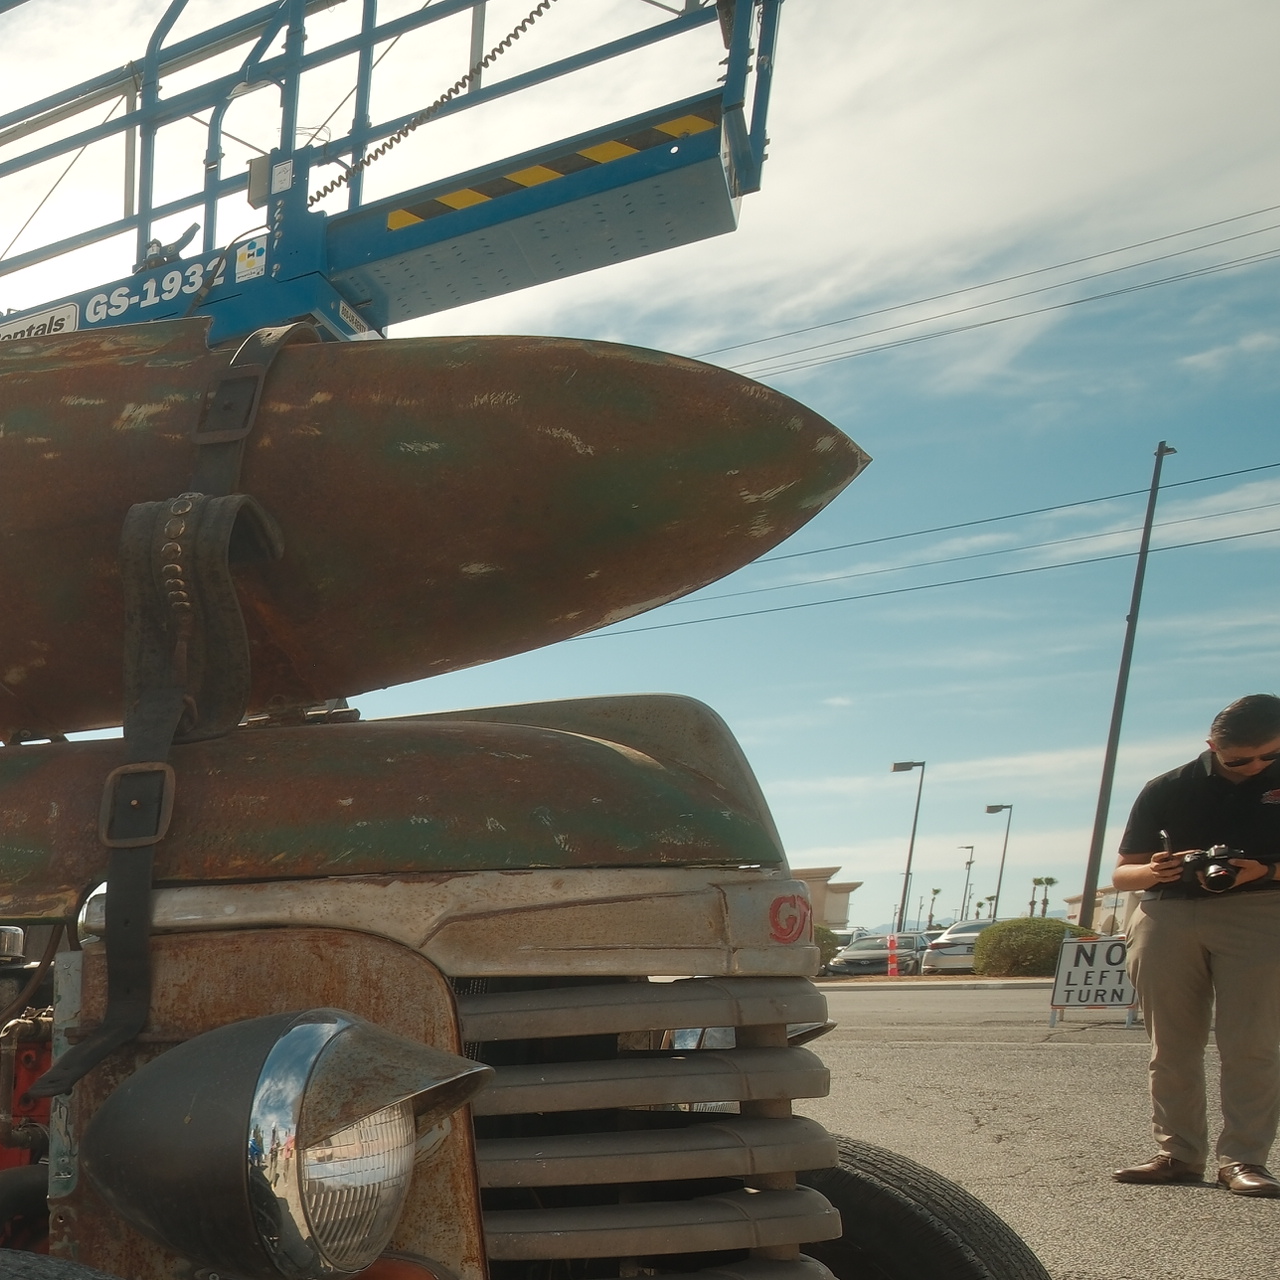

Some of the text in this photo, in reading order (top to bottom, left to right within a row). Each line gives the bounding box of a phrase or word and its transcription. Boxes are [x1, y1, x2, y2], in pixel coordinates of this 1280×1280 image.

[85, 257, 227, 323] GS-1932
[1074, 944, 1126, 967] NO
[1066, 970, 1126, 986] LEFT
[1064, 989, 1124, 1004] TURN
